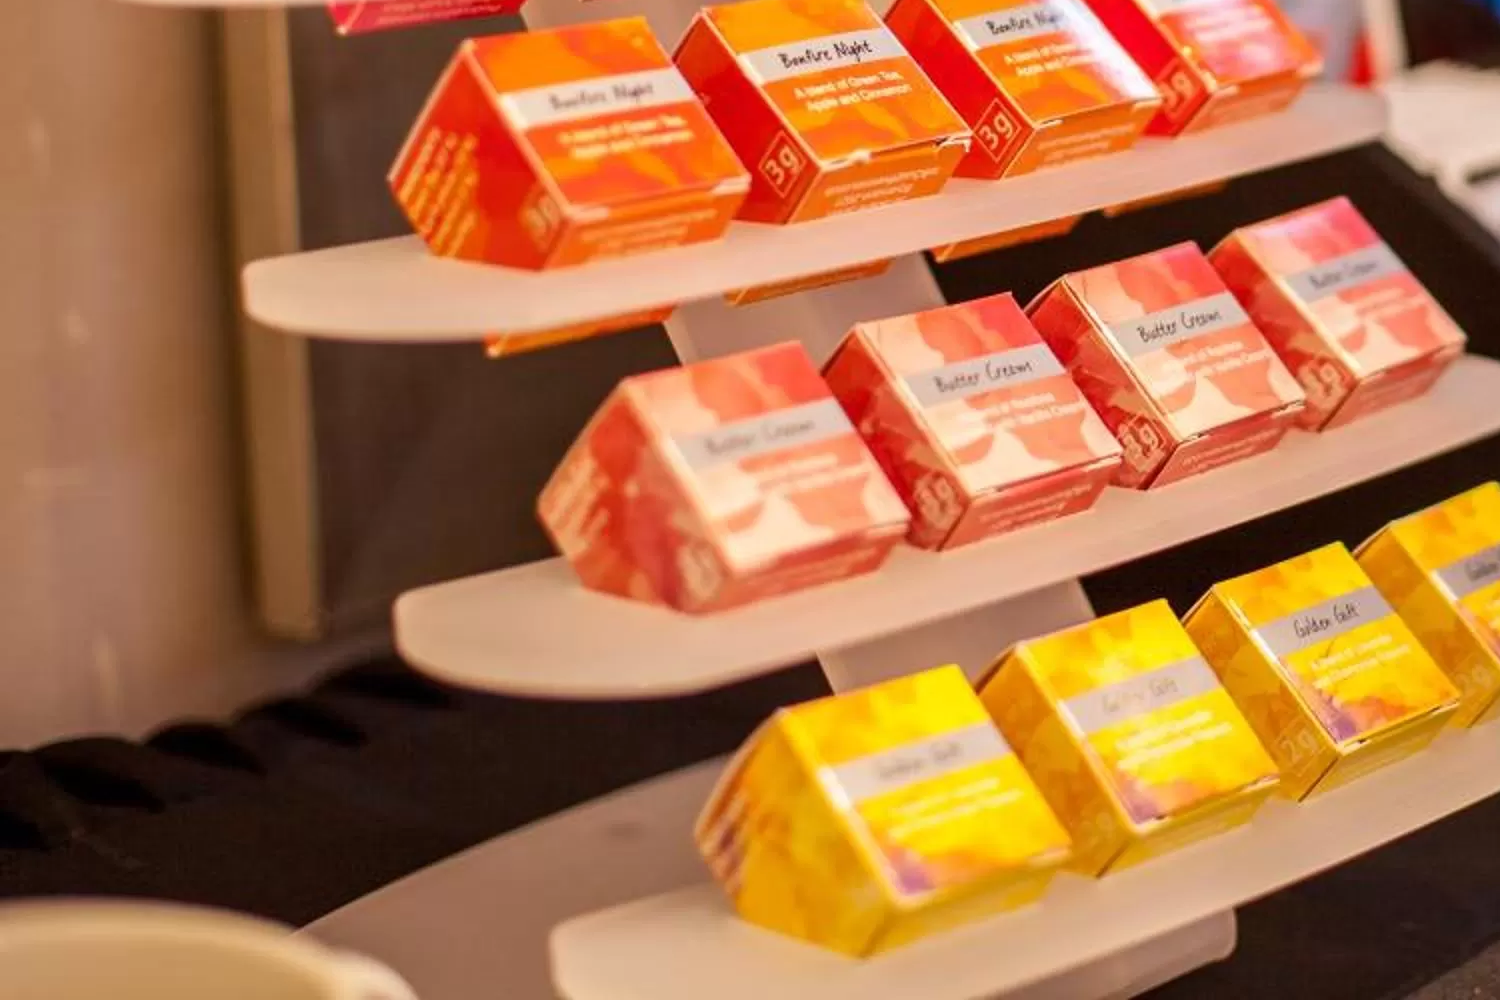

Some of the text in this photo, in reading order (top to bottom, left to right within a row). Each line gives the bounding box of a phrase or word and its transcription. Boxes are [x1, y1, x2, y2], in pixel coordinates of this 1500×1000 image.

[833, 39, 873, 63] Night
[978, 113, 1015, 151] 3g
[764, 145, 800, 185] 3g
[1136, 310, 1221, 343] Butter Cream
